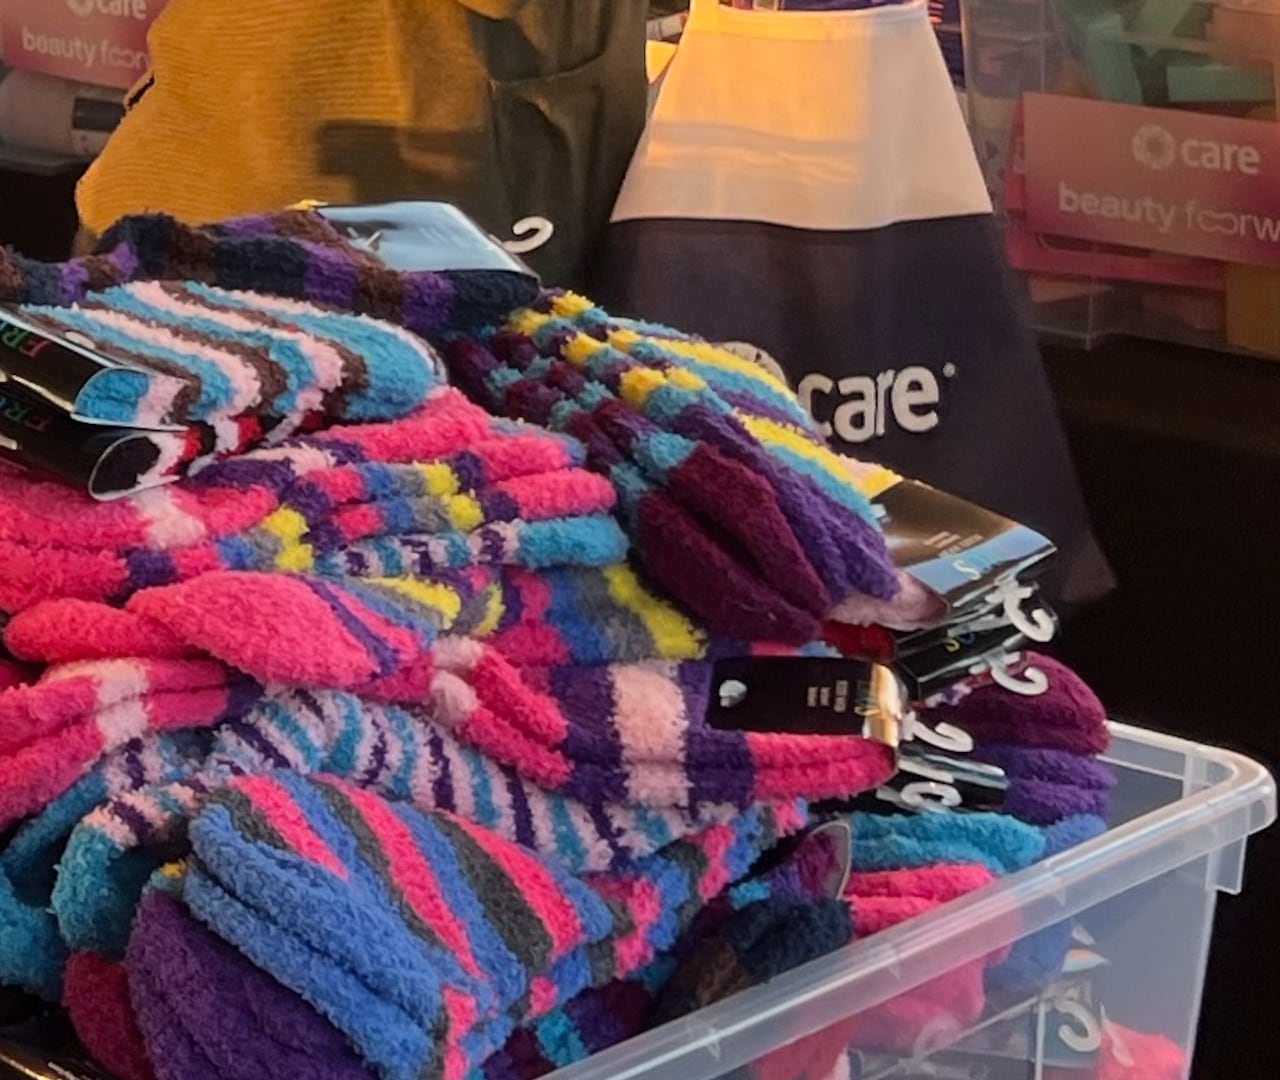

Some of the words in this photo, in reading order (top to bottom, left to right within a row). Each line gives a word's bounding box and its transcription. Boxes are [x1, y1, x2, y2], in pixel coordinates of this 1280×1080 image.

[1181, 137, 1261, 176] care
[1058, 181, 1177, 233] beauty
[797, 365, 940, 442] care
